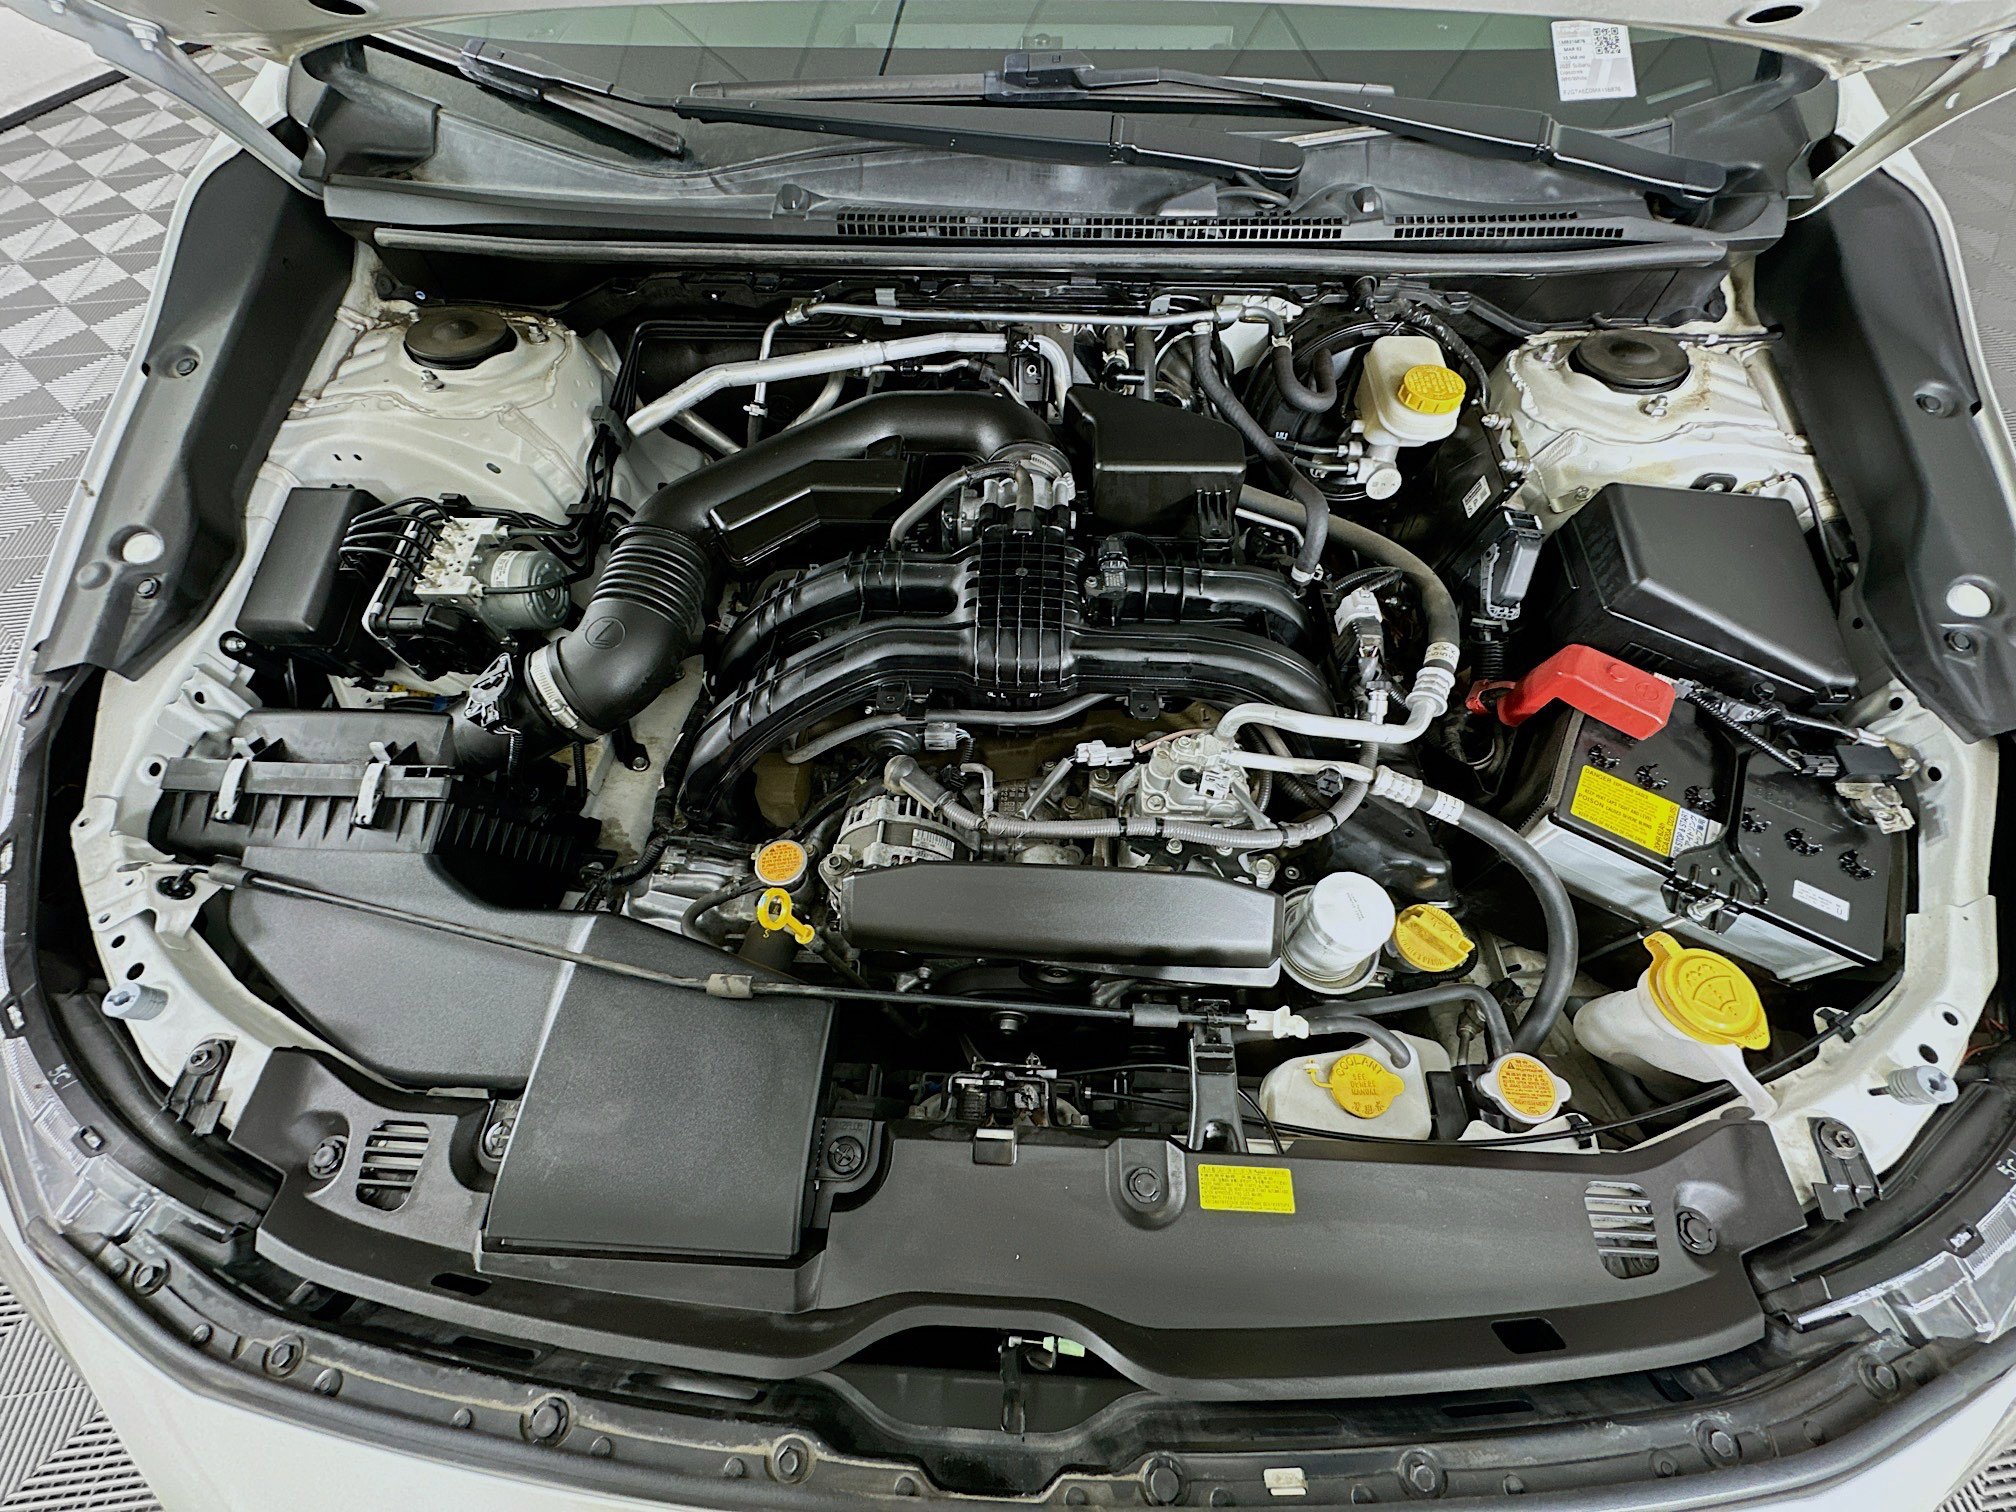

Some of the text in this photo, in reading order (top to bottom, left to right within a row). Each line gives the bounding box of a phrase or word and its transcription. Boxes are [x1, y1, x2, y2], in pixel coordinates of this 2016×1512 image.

[1584, 768, 1612, 782] DANGER
[1578, 793, 1604, 808] POISON
[1336, 1056, 1382, 1076] COOLANT
